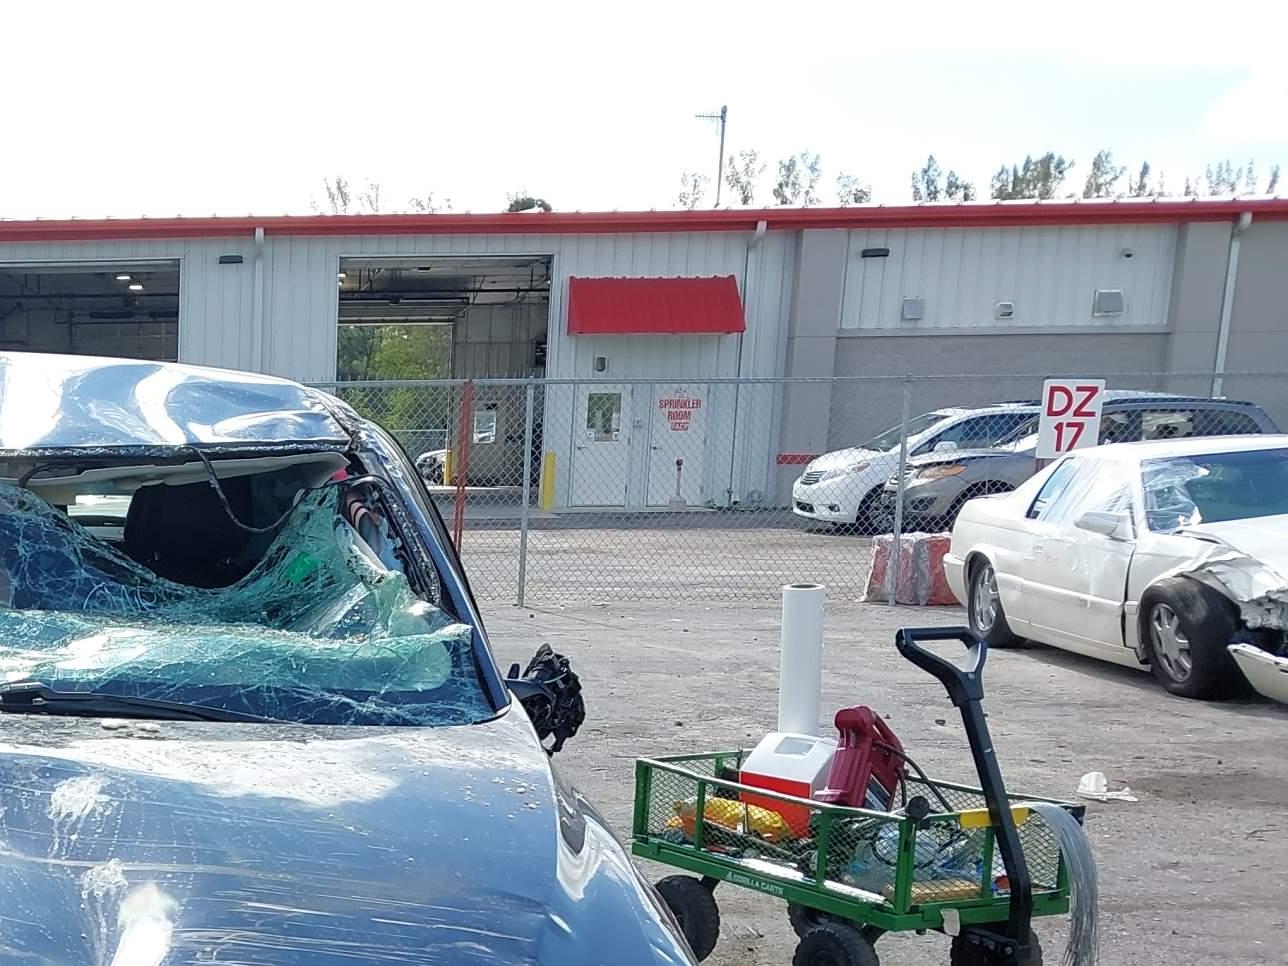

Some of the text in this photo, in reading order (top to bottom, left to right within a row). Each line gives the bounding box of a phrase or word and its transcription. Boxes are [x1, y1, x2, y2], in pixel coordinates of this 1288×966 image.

[658, 399, 702, 409] SPRINKLER
[1047, 386, 1099, 417] DZ
[668, 411, 691, 420] ROOM
[1054, 422, 1085, 452] 17
